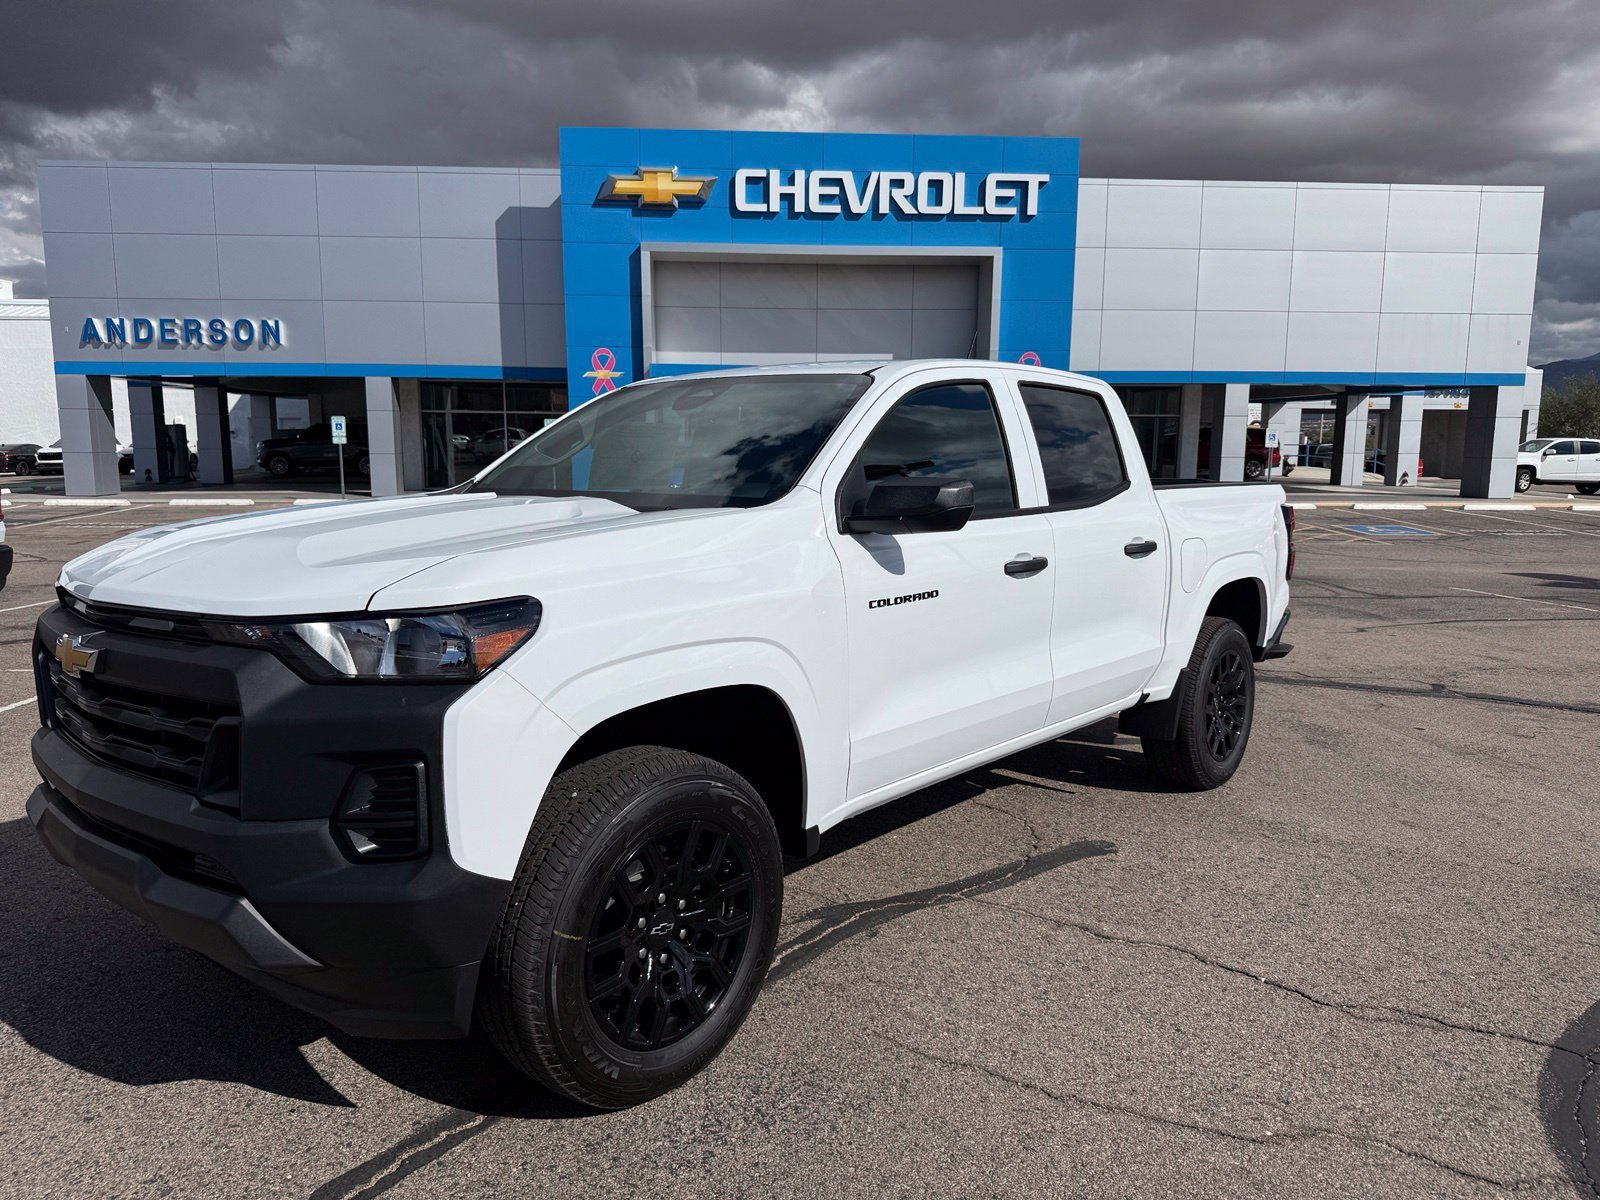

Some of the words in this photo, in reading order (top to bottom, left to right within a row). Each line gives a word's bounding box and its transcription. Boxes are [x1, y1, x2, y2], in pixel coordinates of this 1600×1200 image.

[735, 168, 1050, 216] CHEVROLET
[81, 317, 282, 346] ANDERSON
[868, 589, 939, 609] COLORADO
